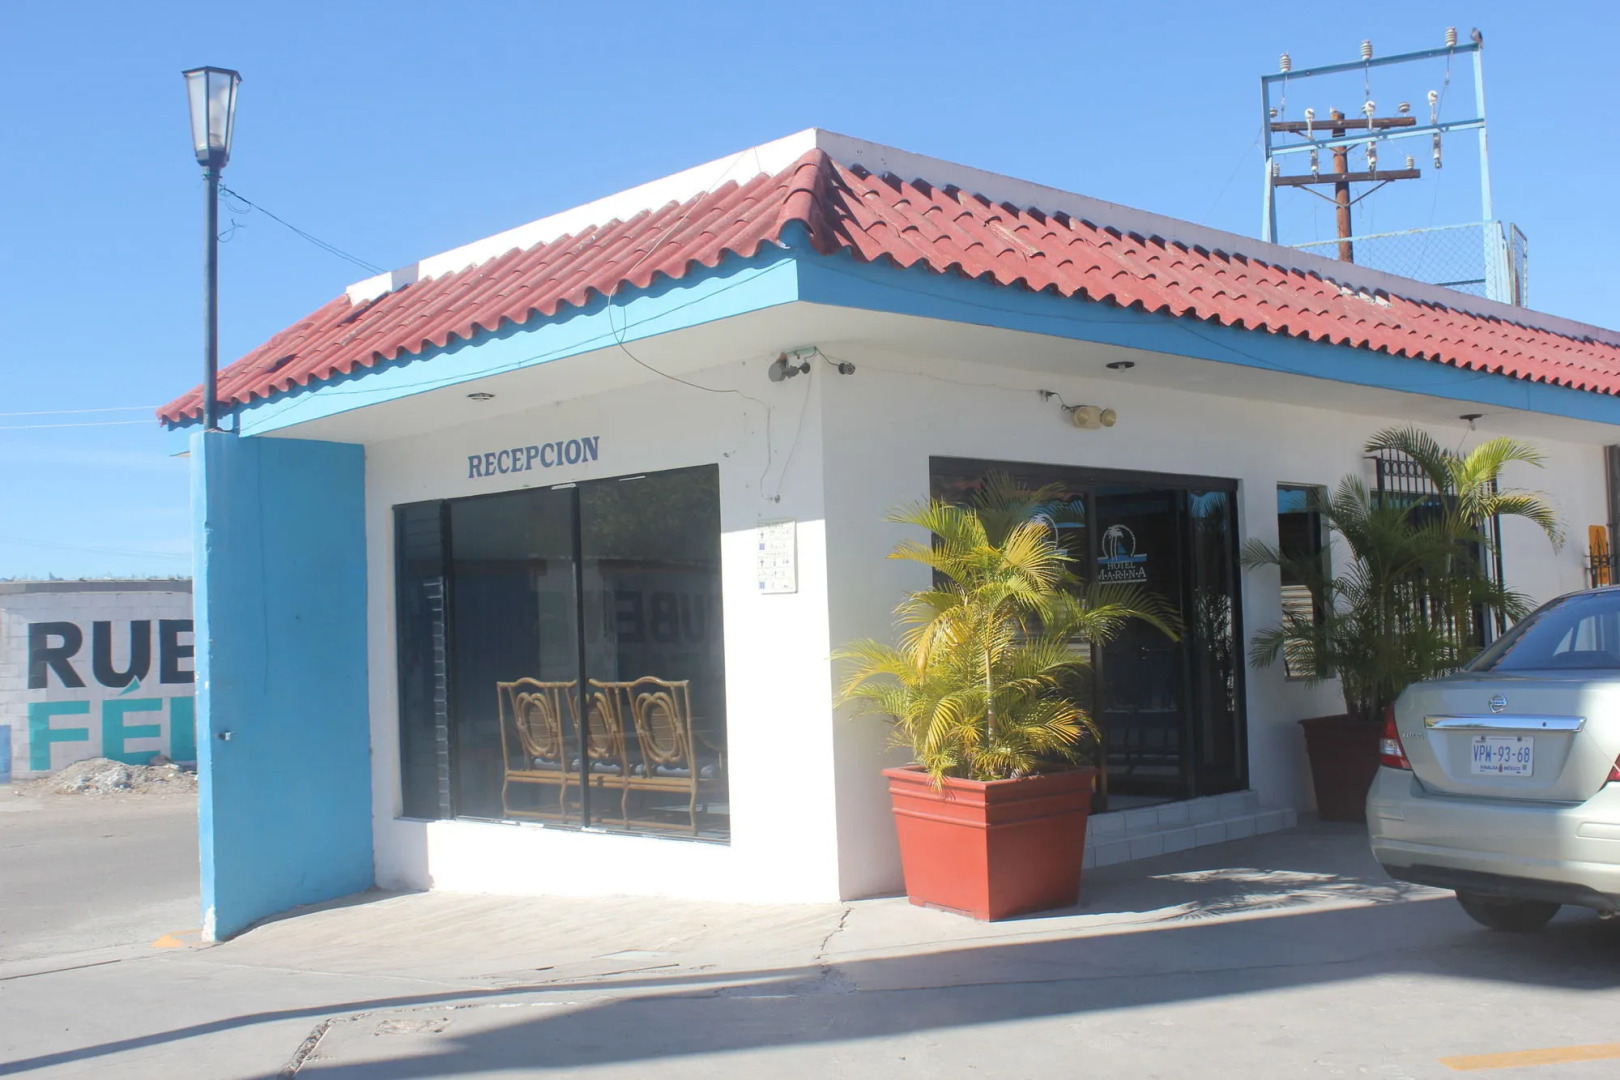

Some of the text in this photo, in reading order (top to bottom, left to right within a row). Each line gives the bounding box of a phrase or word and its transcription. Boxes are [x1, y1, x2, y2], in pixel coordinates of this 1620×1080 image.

[467, 435, 600, 479] RECEPCION
[1107, 561, 1136, 570] HOTEL
[1473, 744, 1530, 764] VPW-93-68
